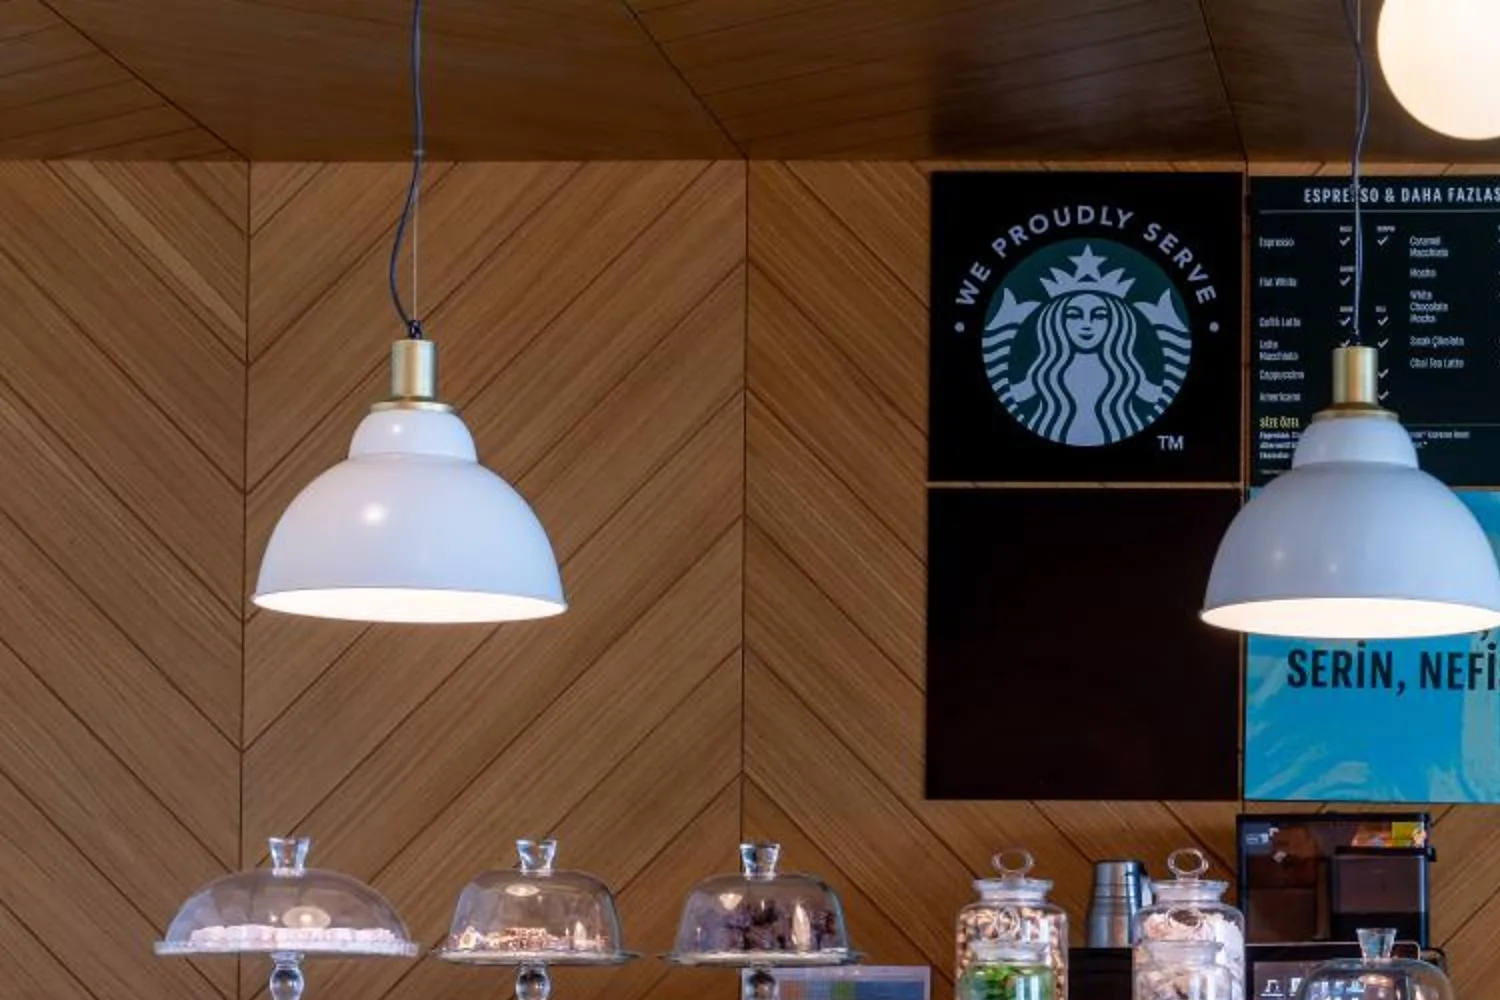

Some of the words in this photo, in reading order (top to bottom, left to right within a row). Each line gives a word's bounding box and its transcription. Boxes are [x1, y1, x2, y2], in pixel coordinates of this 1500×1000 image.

[1385, 188, 1396, 203] &
[1401, 187, 1442, 203] DAHA
[955, 261, 992, 307] WE
[991, 205, 1134, 260] PROUDLY
[1142, 223, 1217, 305] SERVE
[1156, 435, 1184, 451] TM
[1287, 640, 1406, 696] SERİN,
